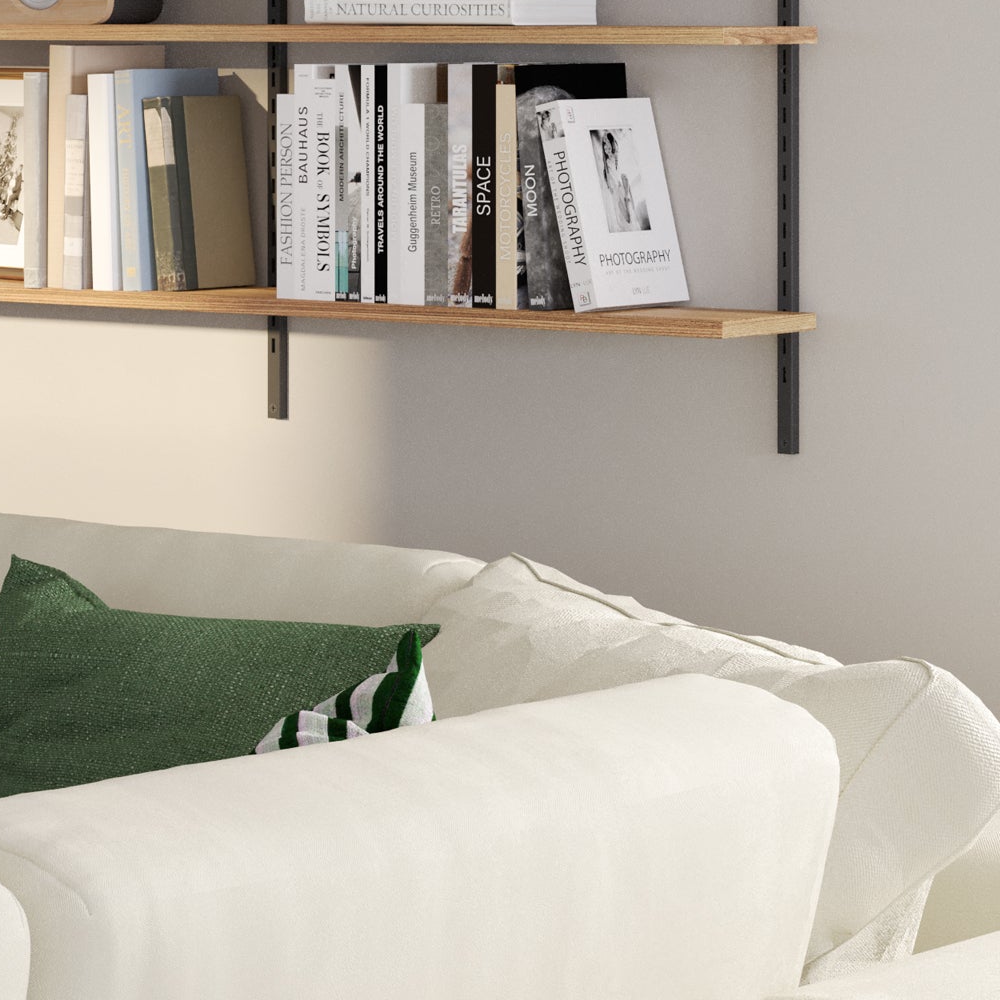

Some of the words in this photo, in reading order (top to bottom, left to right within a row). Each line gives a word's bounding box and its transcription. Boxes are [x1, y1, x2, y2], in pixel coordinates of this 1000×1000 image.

[336, 3, 410, 16] NATURAL
[411, 3, 505, 16] CURIOSITIES
[117, 104, 133, 149] ART
[281, 123, 292, 186] PERSON
[299, 106, 308, 183] BAUHAUS
[317, 132, 329, 176] BOOK
[317, 180, 323, 190] OF
[408, 152, 417, 191] Museum
[452, 144, 467, 233] TARANTULAS
[477, 156, 491, 216] SPACE
[499, 133, 511, 260] MOTORCYCLES
[524, 164, 538, 216] MOON
[281, 192, 292, 265] FASHION
[317, 194, 330, 272] SYMBOLS
[408, 194, 418, 252] Guggenheim
[431, 186, 441, 225] RETRO
[553, 151, 587, 266] PHOTOGRAPHY
[599, 249, 670, 267] PHOTOGRAPHY
